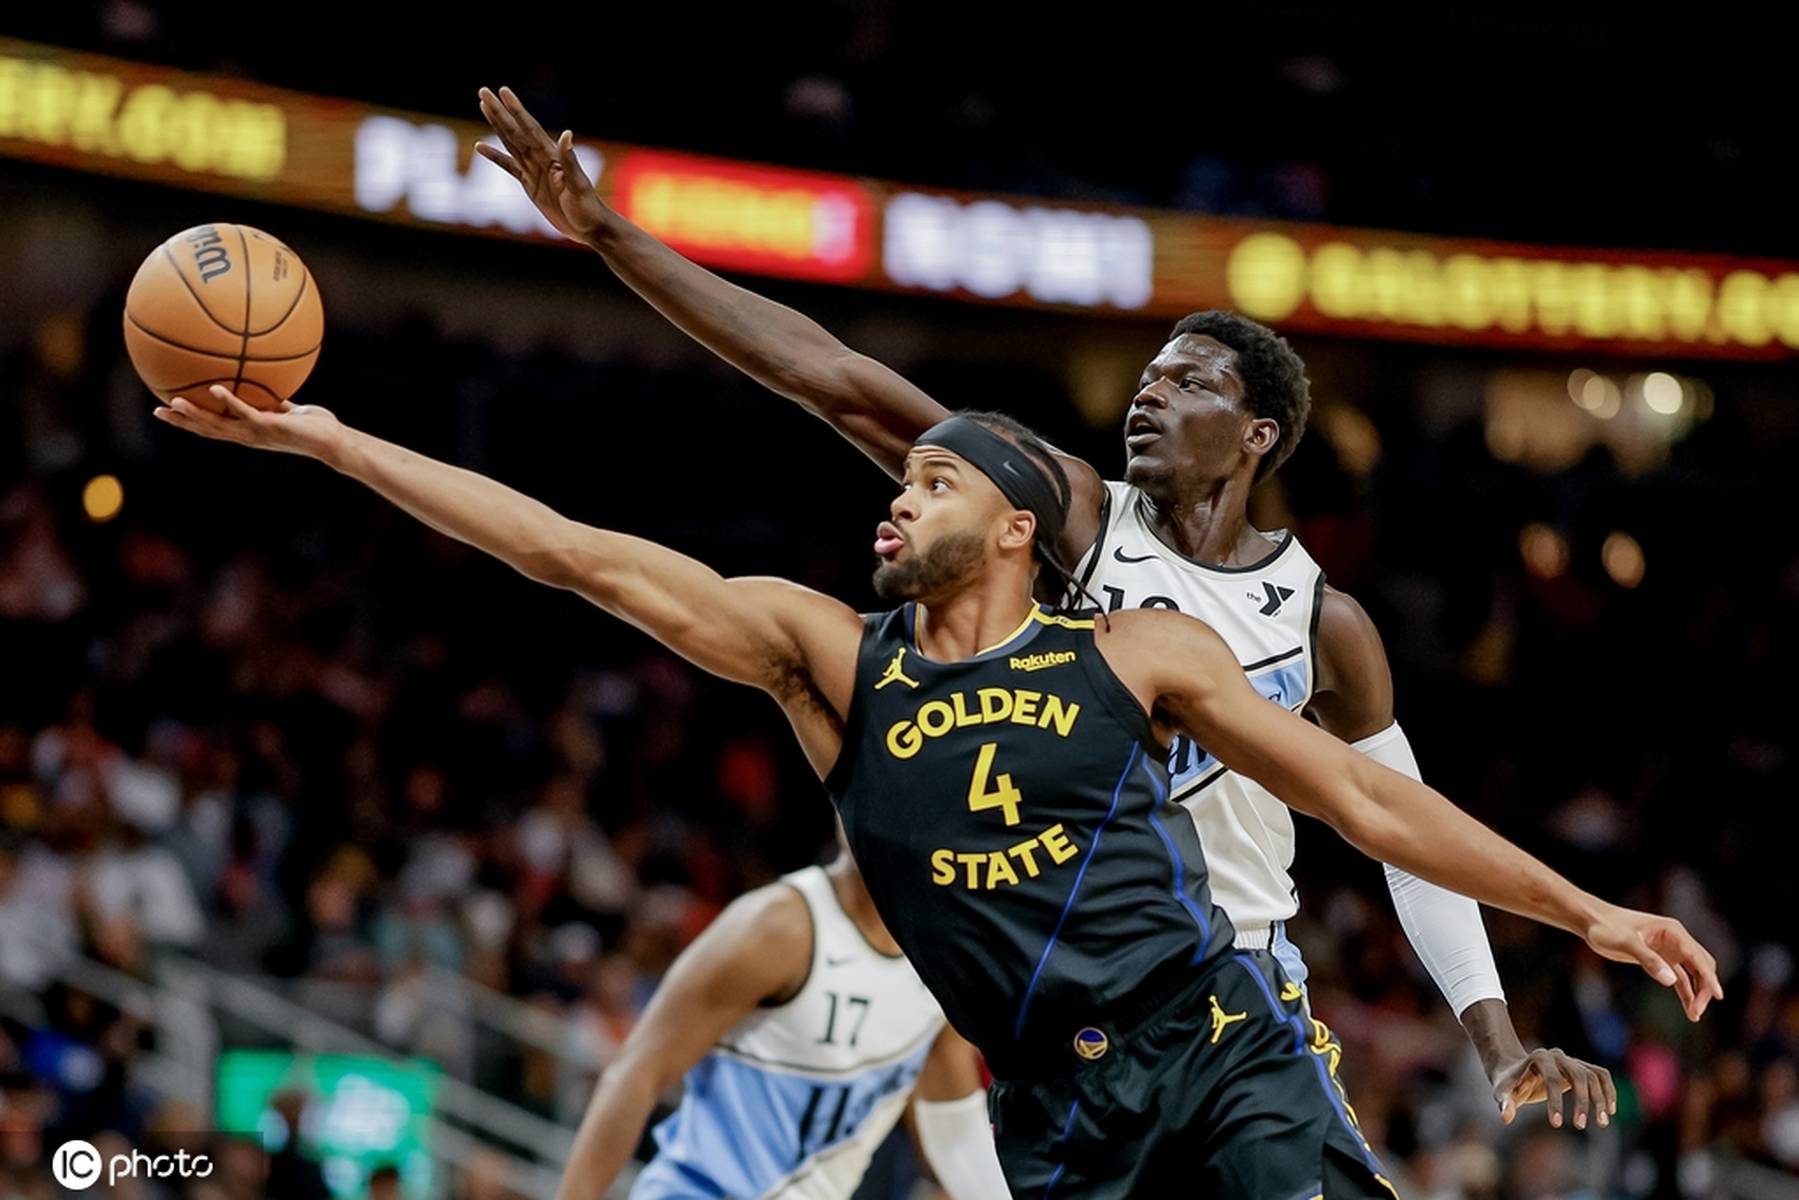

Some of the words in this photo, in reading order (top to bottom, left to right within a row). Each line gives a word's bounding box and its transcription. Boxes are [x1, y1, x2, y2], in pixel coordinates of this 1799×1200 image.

[1010, 651, 1076, 672] Rakuten
[886, 687, 1080, 759] GOLDEN
[968, 743, 1022, 826] 4
[931, 823, 1079, 890] STATE
[816, 991, 870, 1046] 17
